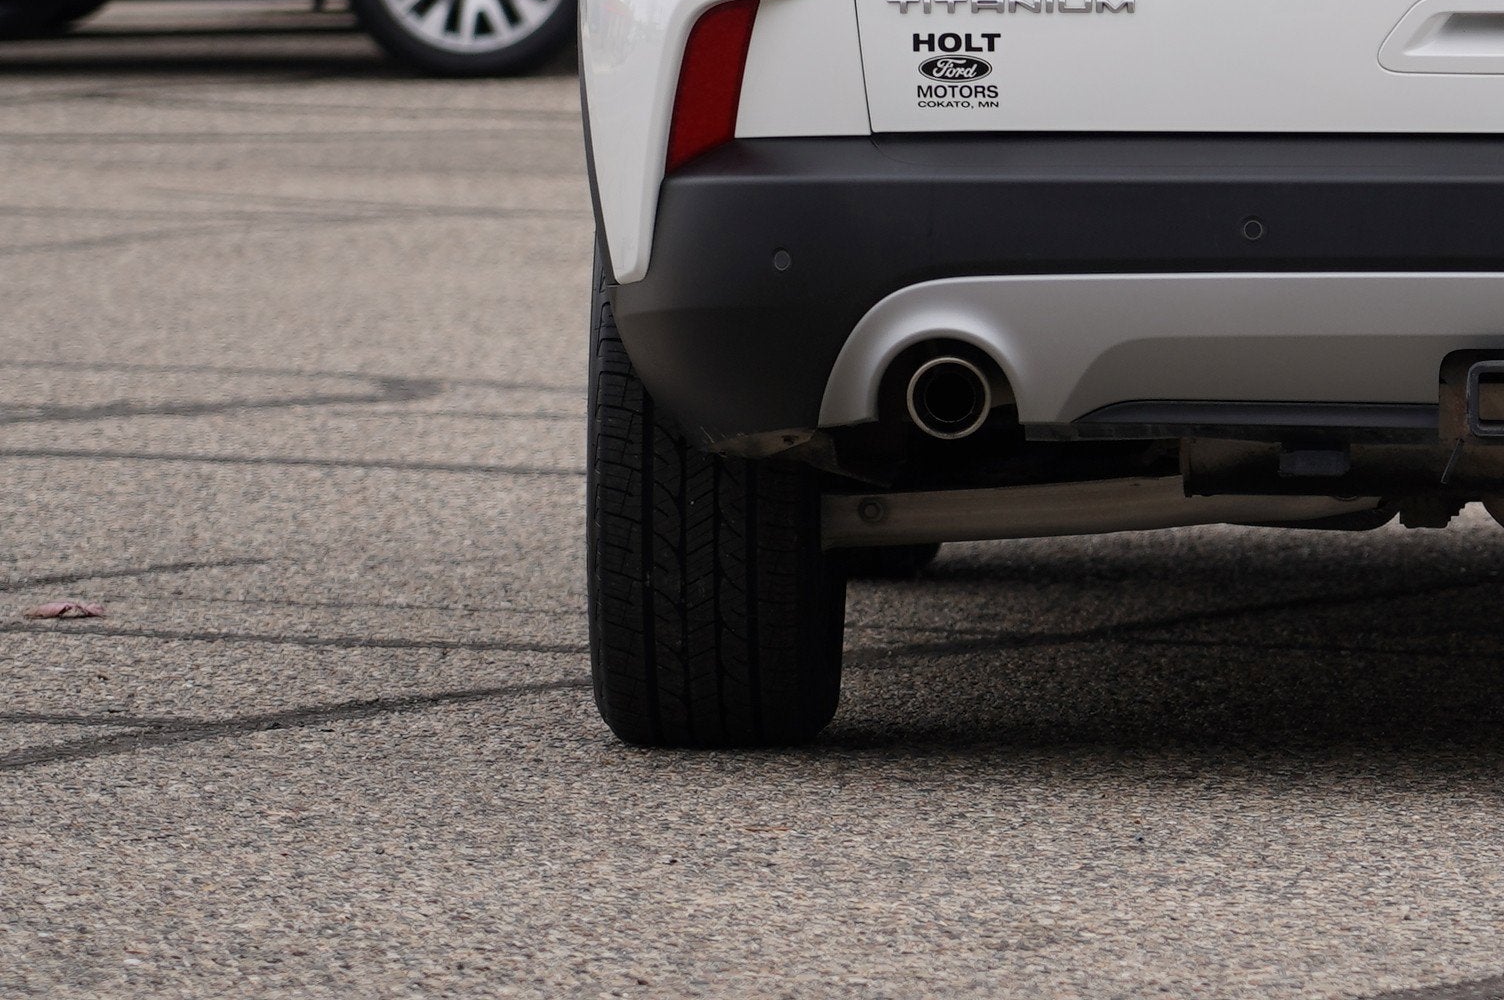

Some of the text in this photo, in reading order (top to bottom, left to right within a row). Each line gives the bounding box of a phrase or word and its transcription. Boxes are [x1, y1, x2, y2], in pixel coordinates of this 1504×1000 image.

[912, 33, 1001, 52] HOLT
[932, 58, 978, 78] Ford
[917, 85, 999, 99] MOTORS
[917, 101, 974, 109] COKATO,
